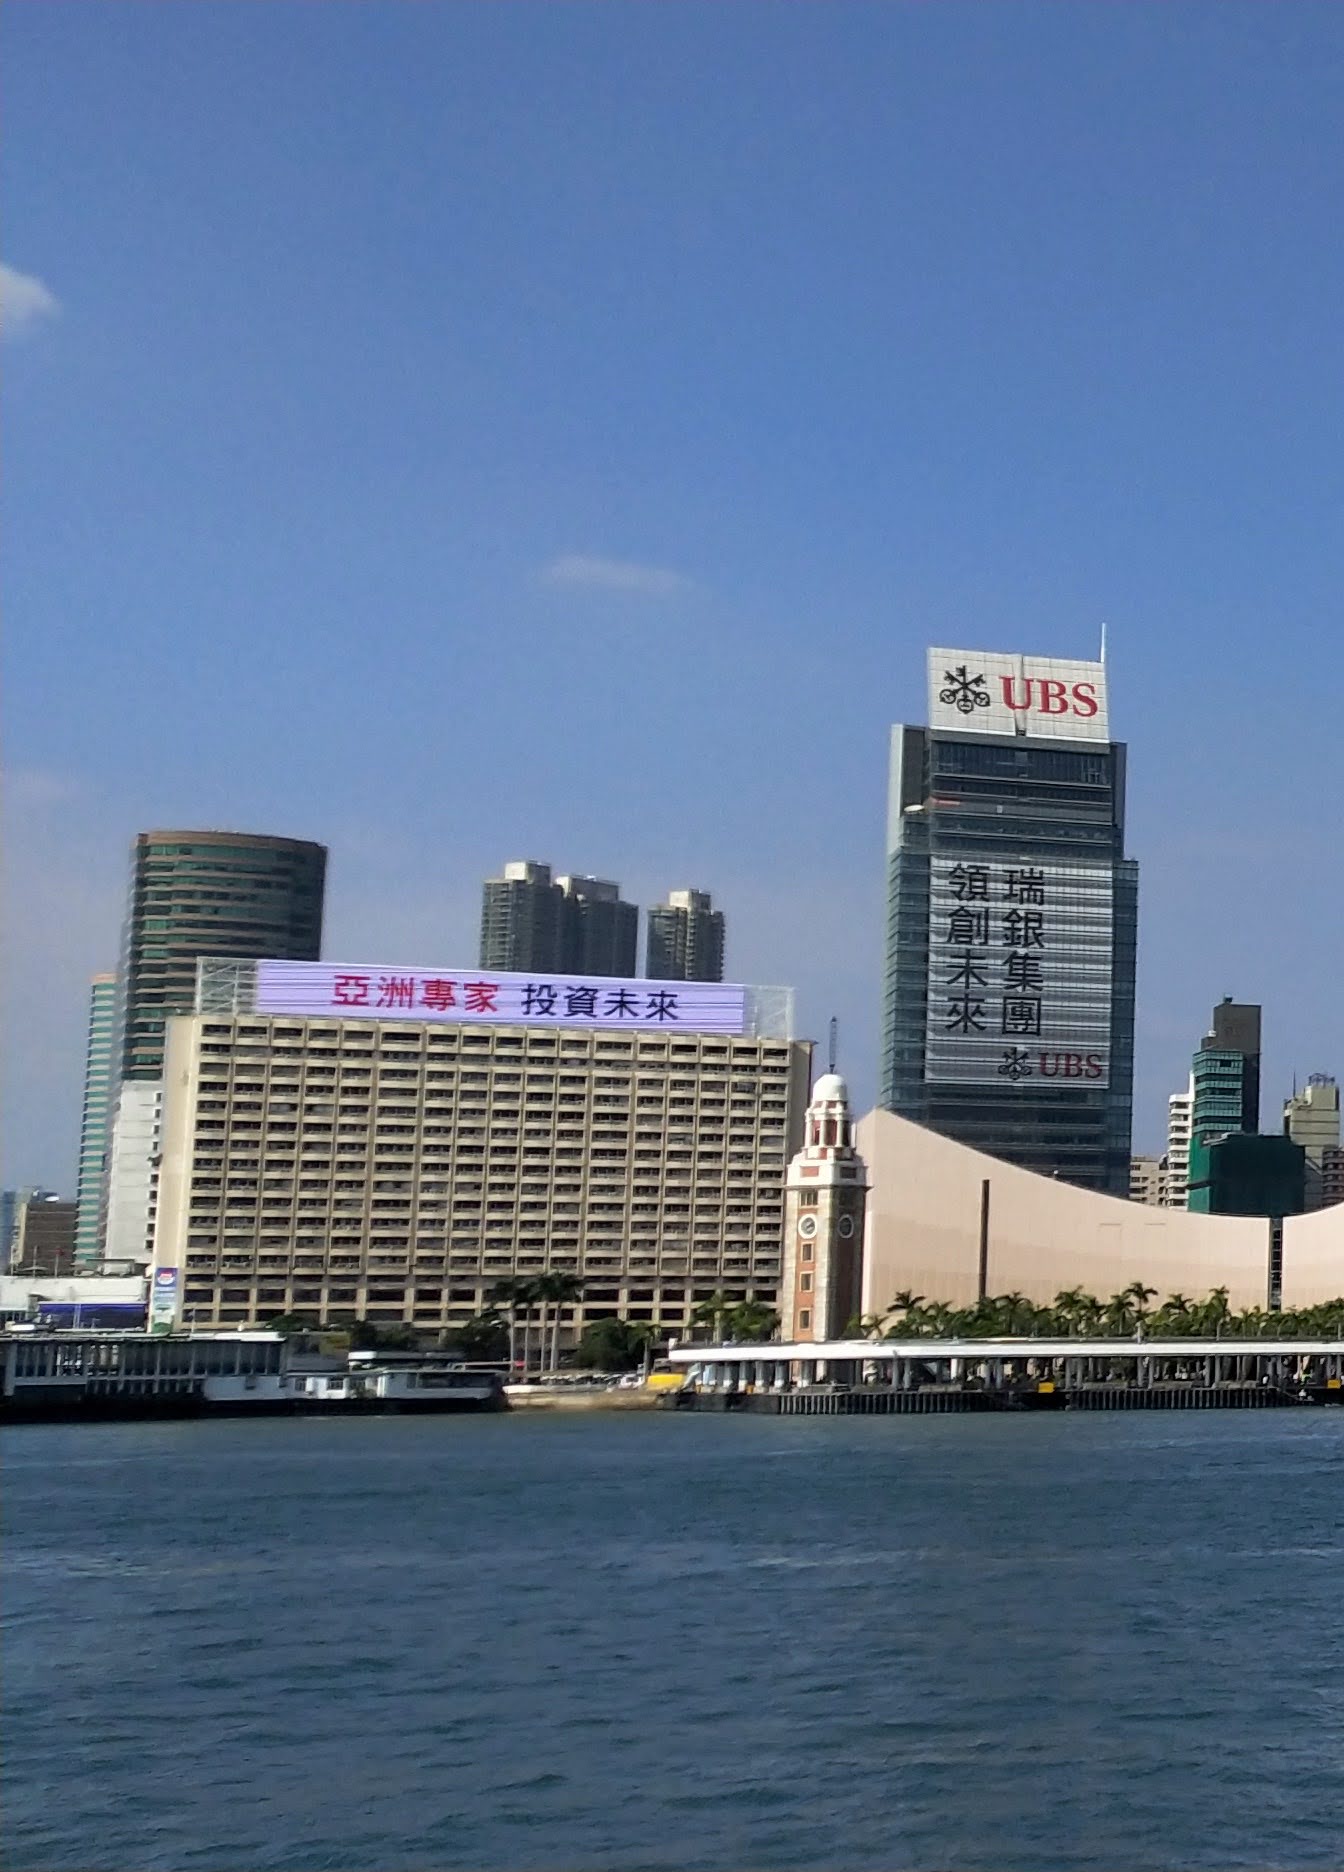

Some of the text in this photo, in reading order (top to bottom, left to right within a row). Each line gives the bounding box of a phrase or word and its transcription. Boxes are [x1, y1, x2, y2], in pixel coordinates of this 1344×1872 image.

[999, 676, 1098, 717] UBS
[945, 863, 990, 1033] 領創未來
[1002, 867, 1045, 1036] 瑞銀集團
[332, 974, 679, 1021] 亞洲專家 投資未來
[1037, 1053, 1103, 1079] UBS
